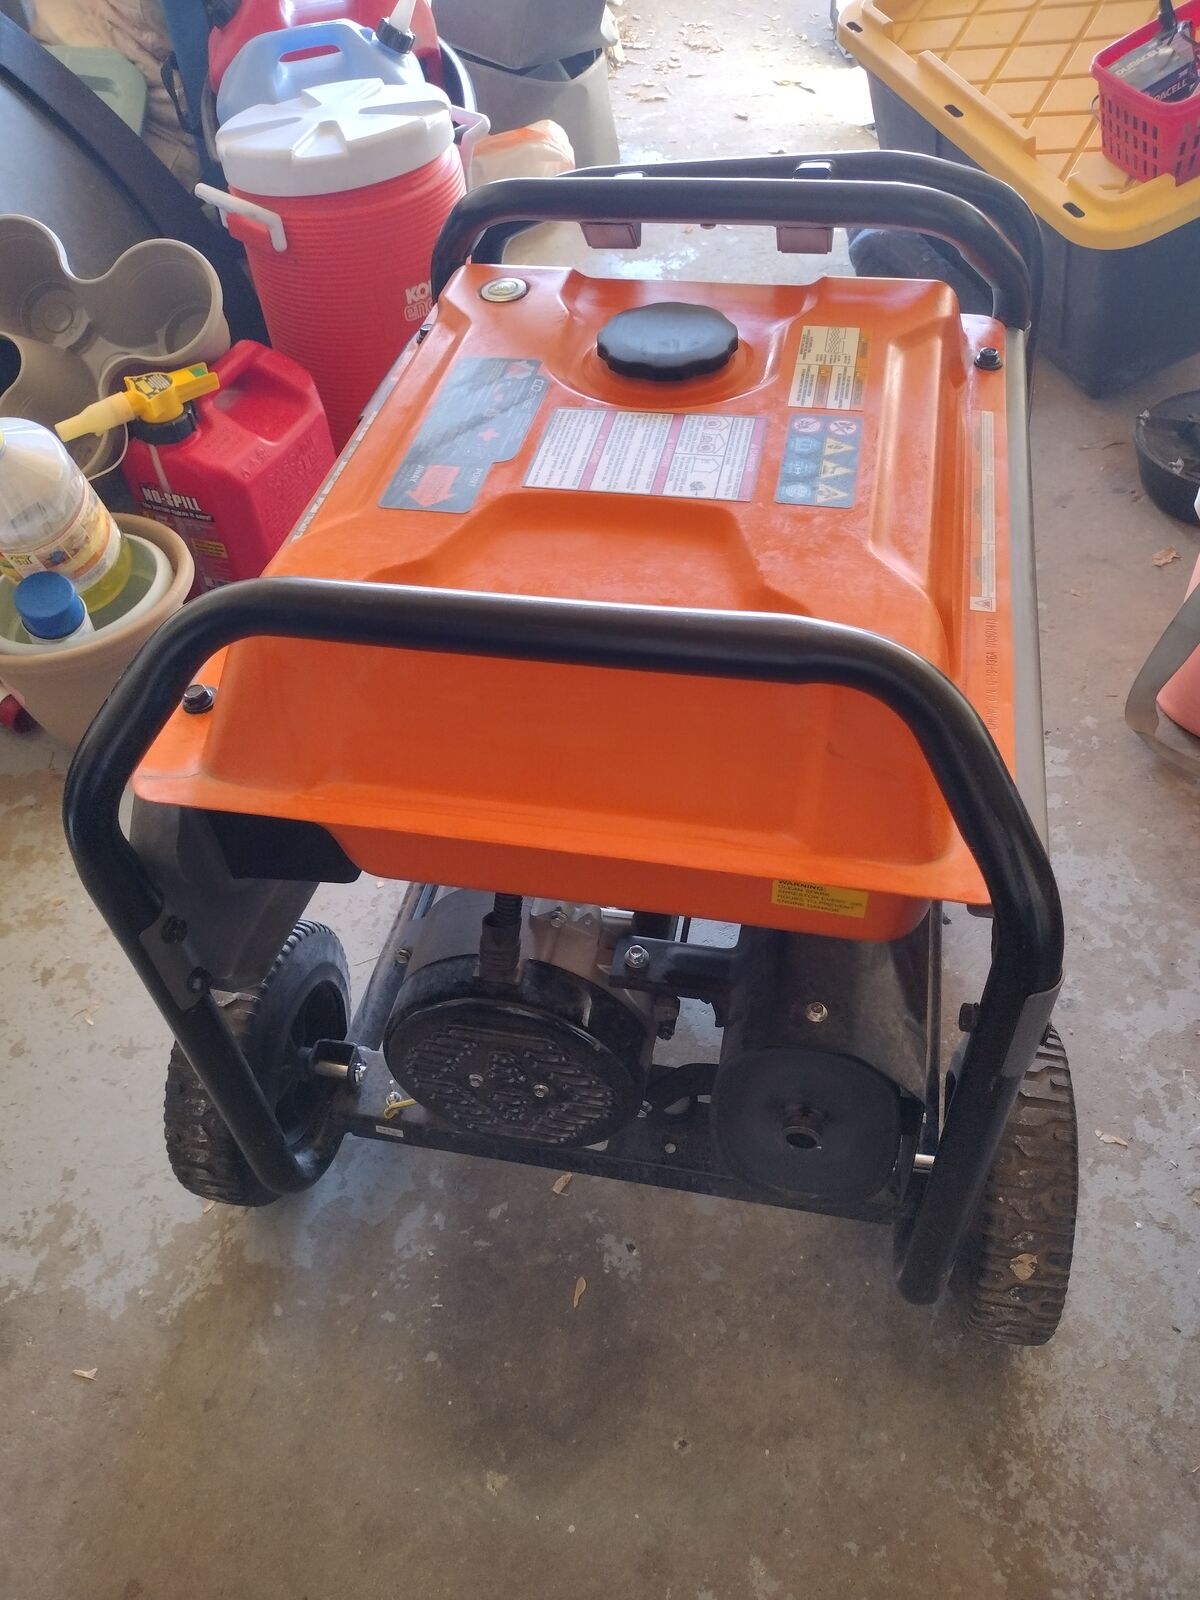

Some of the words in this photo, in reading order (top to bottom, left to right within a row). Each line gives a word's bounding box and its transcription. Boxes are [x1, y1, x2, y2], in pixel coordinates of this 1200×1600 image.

[1115, 49, 1159, 75] DURACEL
[1154, 79, 1187, 100] RACELL
[142, 487, 202, 512] NO-SPILL
